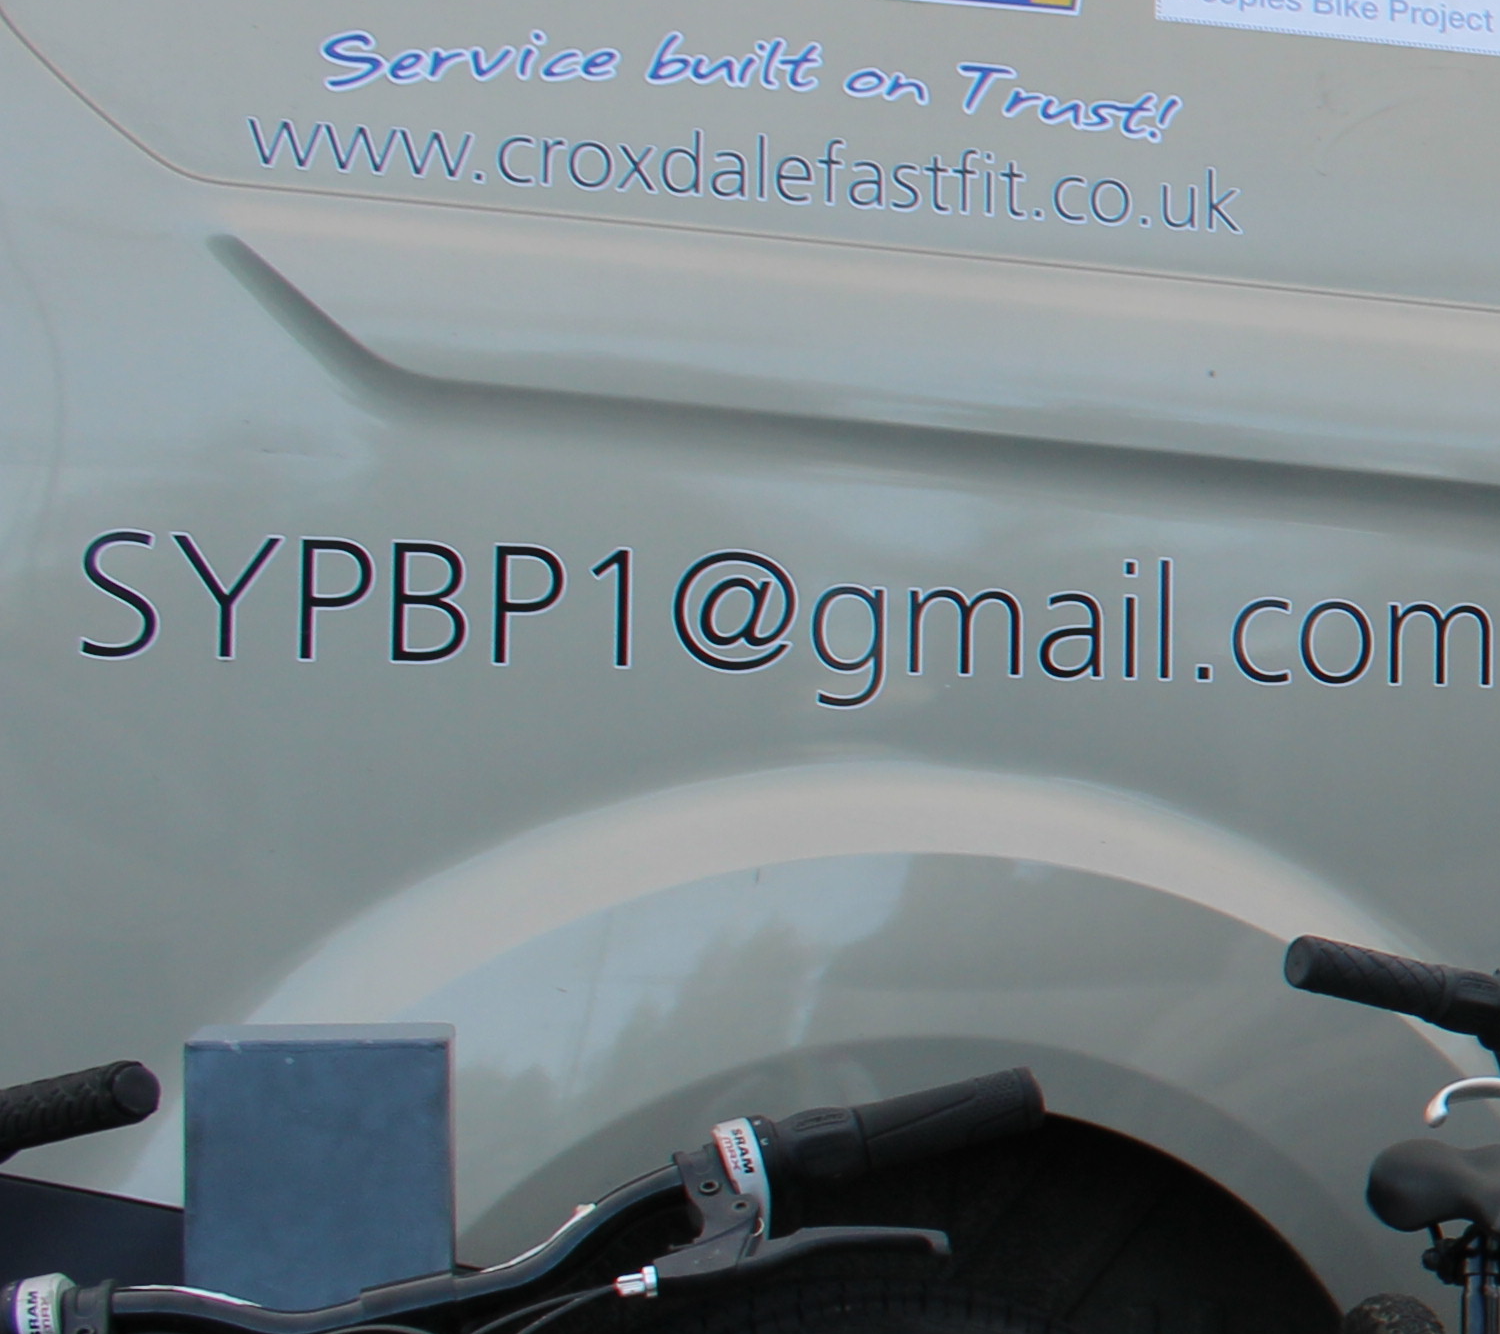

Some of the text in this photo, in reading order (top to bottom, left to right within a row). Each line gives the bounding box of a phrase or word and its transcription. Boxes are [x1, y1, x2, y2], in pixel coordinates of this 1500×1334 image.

[321, 28, 1184, 145] Service built on Trust!
[247, 115, 1244, 236] www.croxdalefastfit.co.uk
[77, 529, 1496, 710] SYPBP1@gmail.com
[731, 1129, 755, 1174] SRAM
